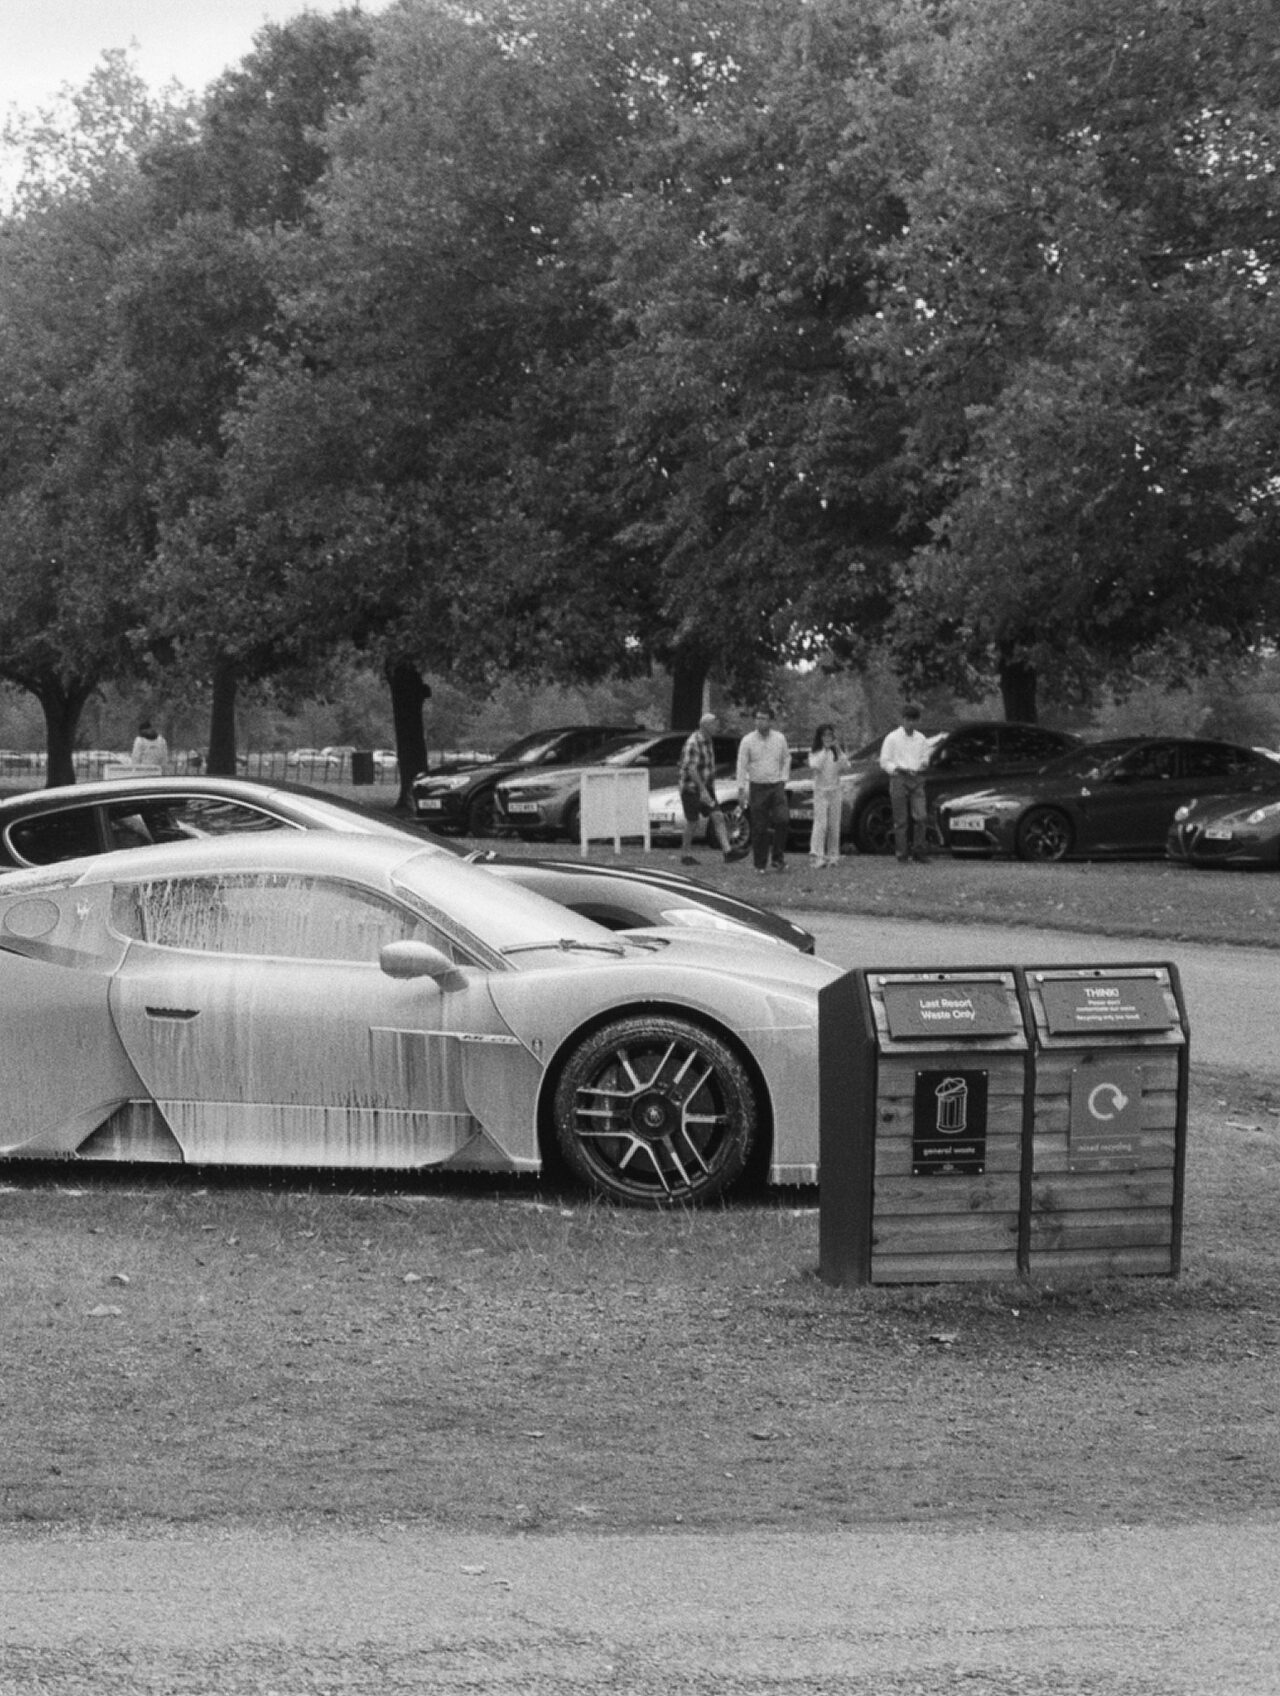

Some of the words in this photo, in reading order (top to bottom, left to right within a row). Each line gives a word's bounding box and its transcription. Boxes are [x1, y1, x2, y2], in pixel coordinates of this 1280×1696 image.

[919, 999, 940, 1009] Last
[941, 998, 972, 1008] Resort
[920, 1010, 951, 1020] Waste
[952, 1010, 976, 1021] Only
[923, 1146, 952, 1156] general
